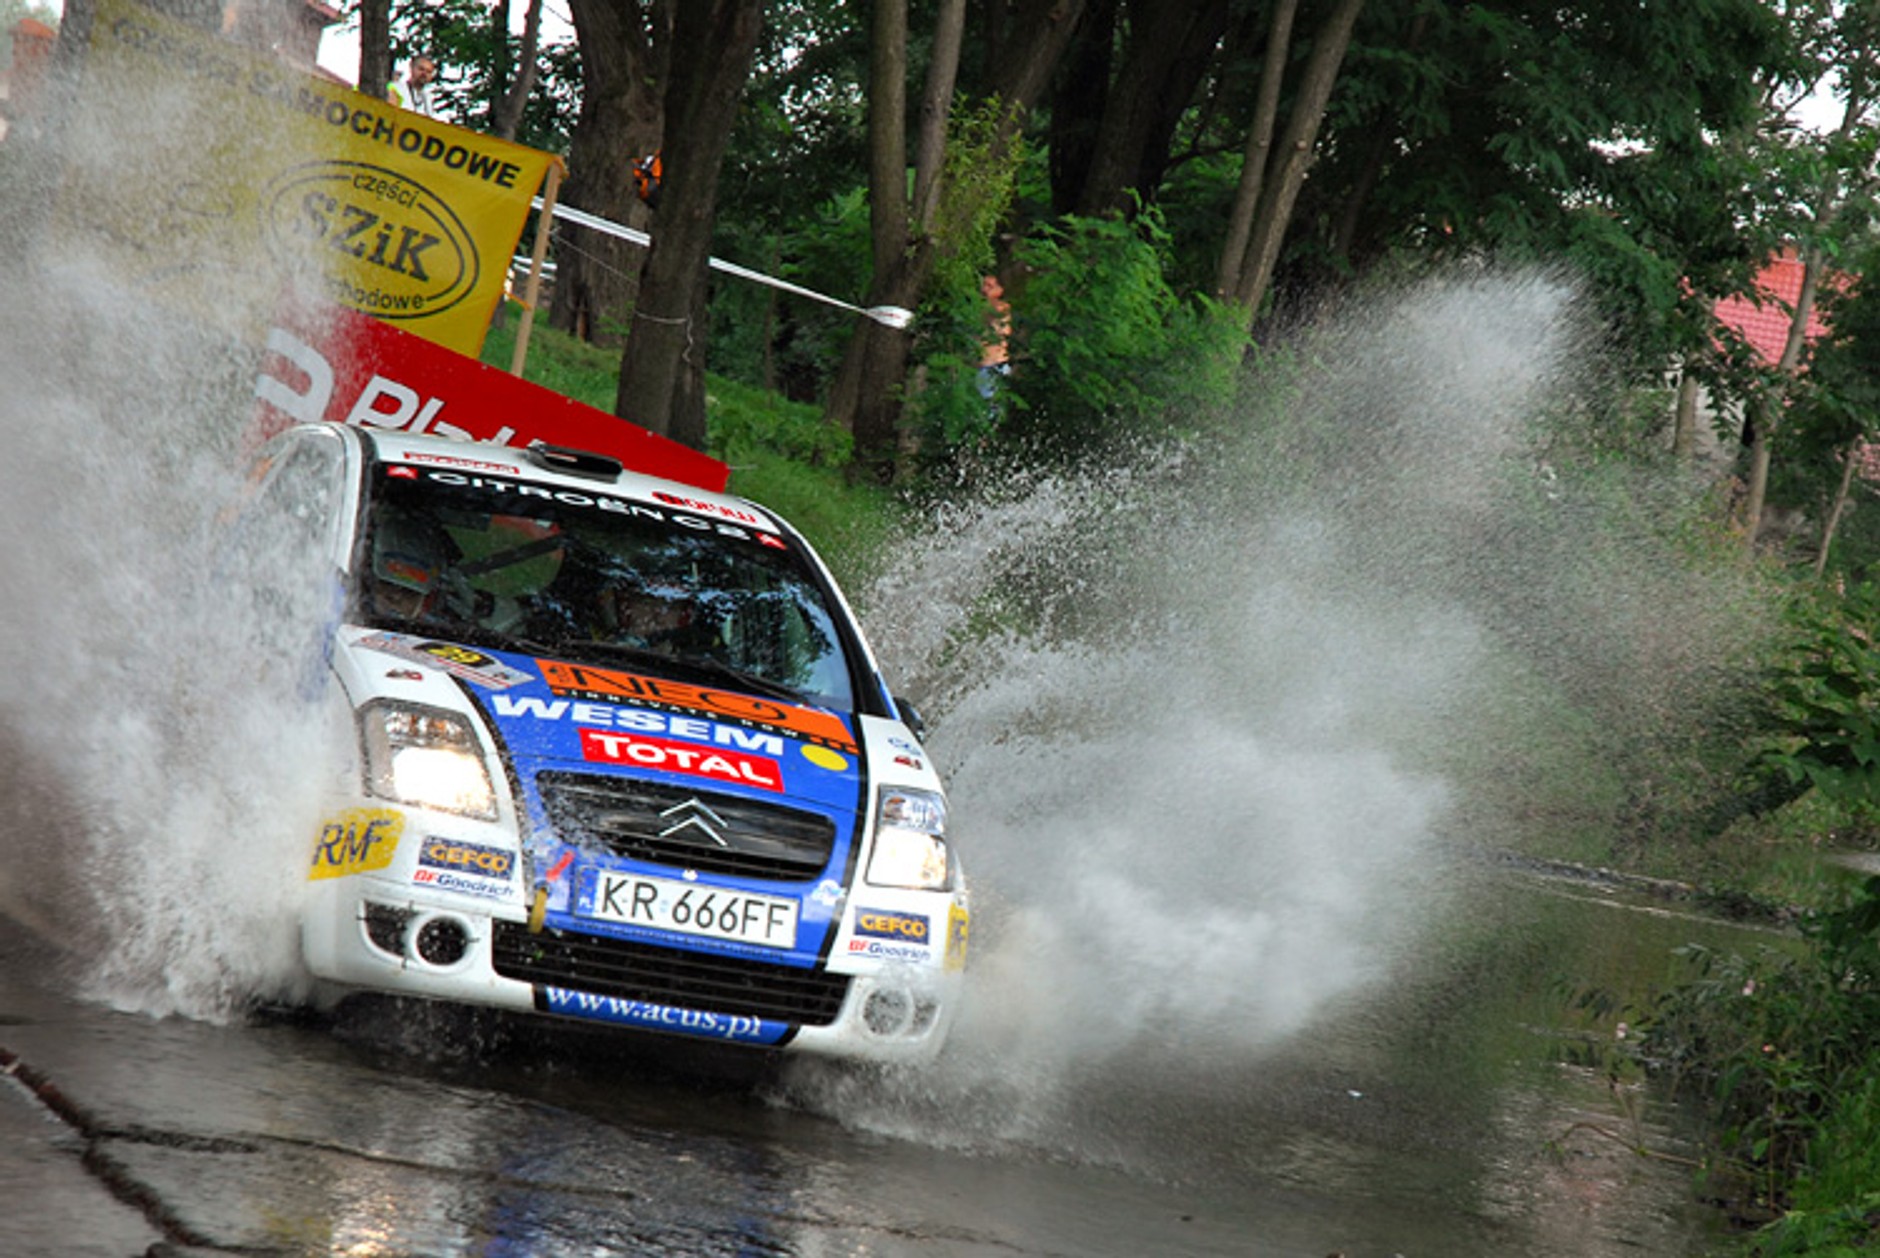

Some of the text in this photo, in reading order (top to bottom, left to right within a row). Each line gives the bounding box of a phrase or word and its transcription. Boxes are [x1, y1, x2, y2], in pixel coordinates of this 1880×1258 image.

[353, 172, 419, 209] części
[293, 191, 440, 283] SZiK
[490, 694, 784, 757] WESEM
[589, 733, 775, 786] TOTAL
[312, 819, 393, 867] RMF
[428, 844, 509, 873] GEFCO
[414, 869, 514, 897] BFGoodrich
[601, 877, 790, 939] KR 666FF
[860, 913, 927, 938] GEFCO
[849, 939, 931, 961] BFGoodrich
[546, 985, 763, 1039] www.acus.pl
